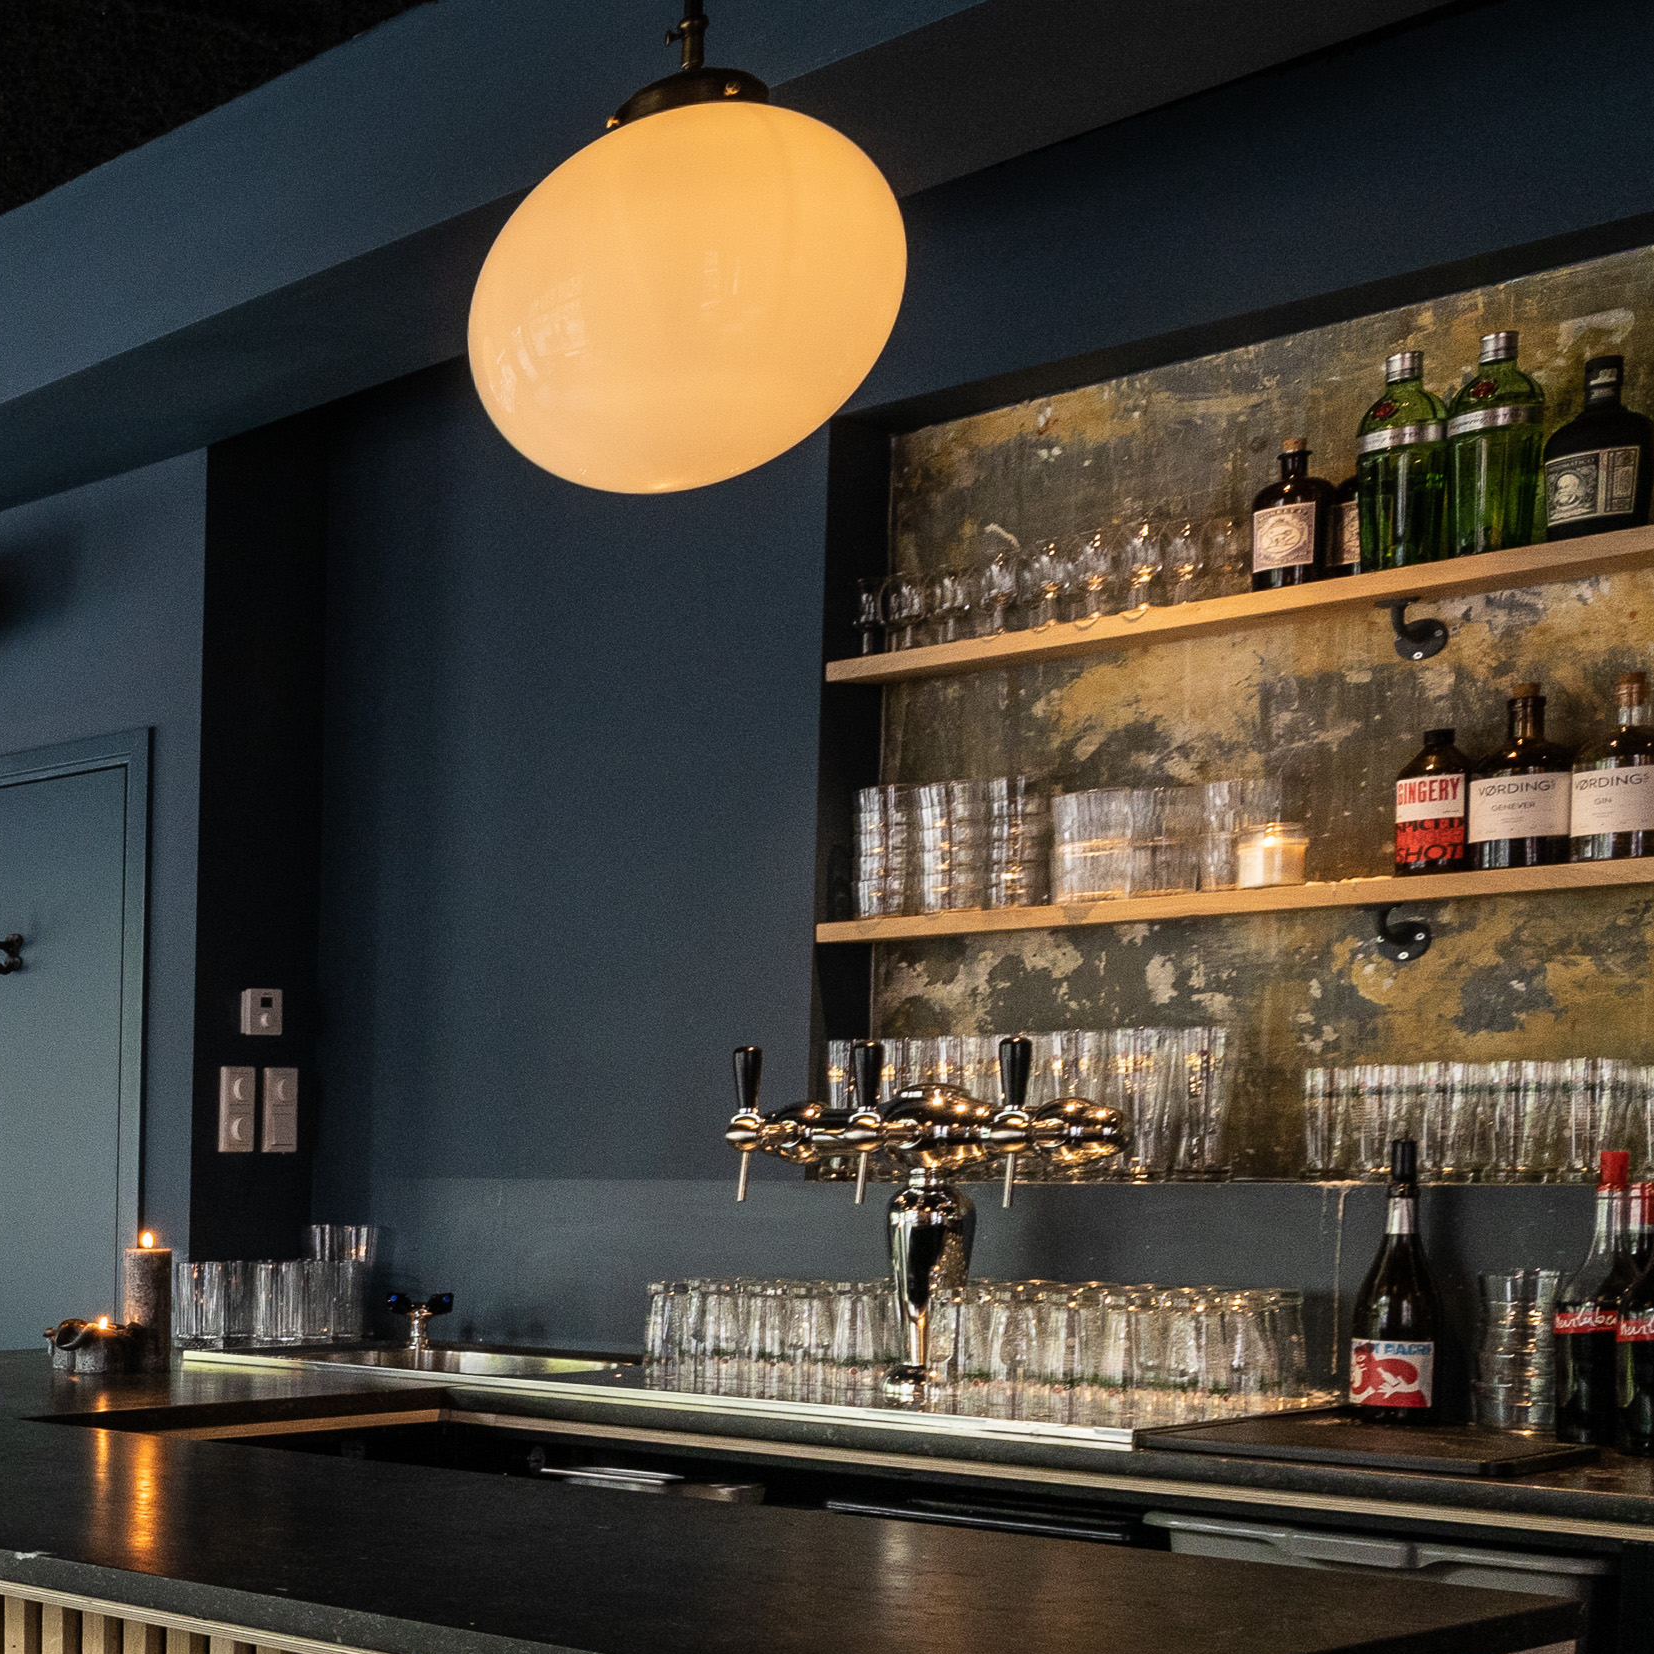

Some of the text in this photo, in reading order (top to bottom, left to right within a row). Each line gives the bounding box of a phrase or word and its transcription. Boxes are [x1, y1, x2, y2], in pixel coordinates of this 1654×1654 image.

[1397, 777, 1460, 806] GINGERY
[1491, 801, 1536, 812] GENEVER
[1594, 797, 1612, 806] GIN
[1396, 843, 1464, 863] SHOT
